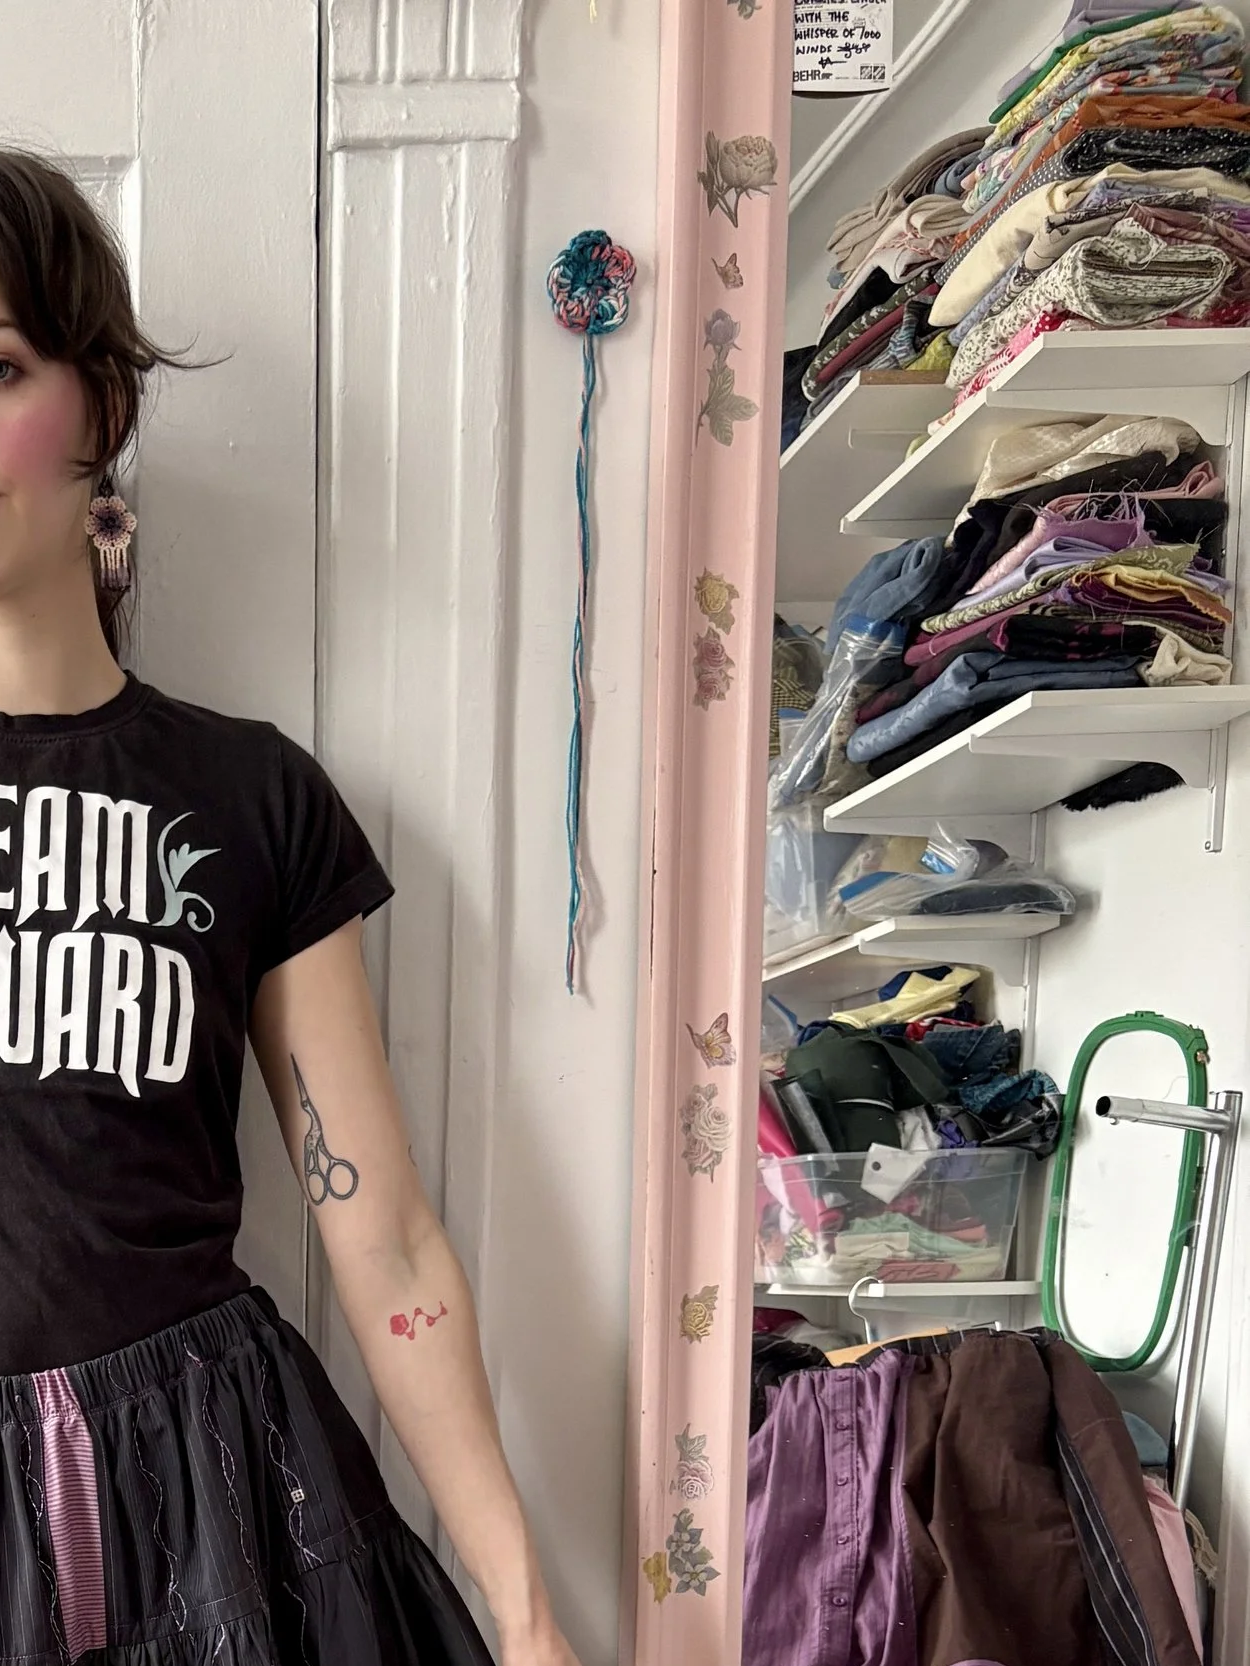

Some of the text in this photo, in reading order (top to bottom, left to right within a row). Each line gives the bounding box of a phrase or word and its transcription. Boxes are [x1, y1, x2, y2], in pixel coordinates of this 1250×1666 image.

[794, 11, 849, 24] WITH THE
[794, 27, 839, 41] WHISPER
[842, 28, 855, 39] OF
[796, 45, 832, 55] WINDS
[793, 69, 821, 82] BEHR
